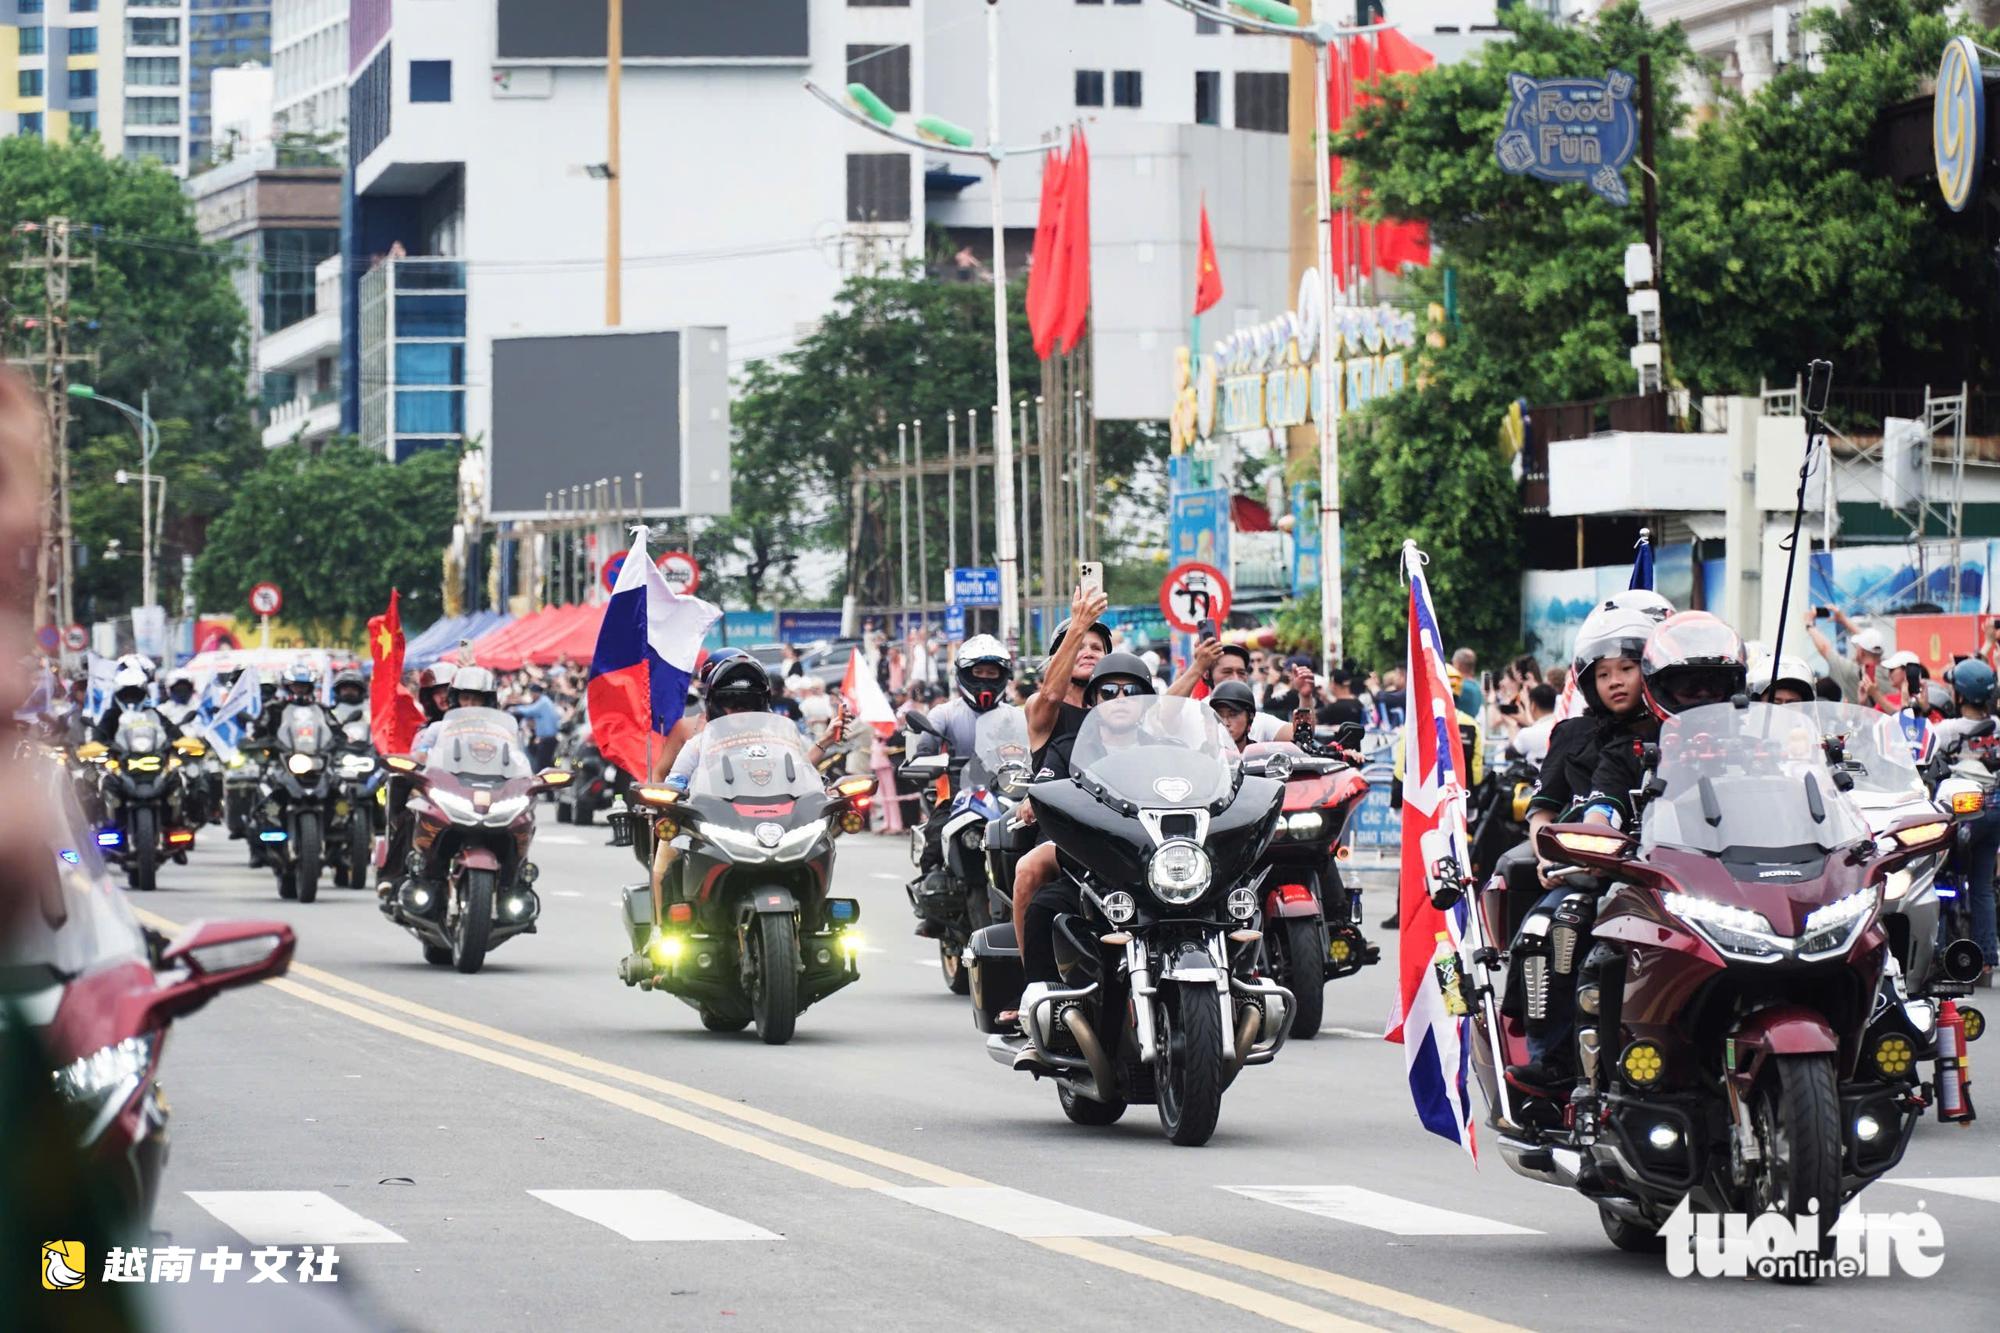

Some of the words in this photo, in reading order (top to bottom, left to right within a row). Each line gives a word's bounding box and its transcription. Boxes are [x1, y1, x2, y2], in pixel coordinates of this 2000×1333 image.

[1538, 87, 1614, 122] Food
[1539, 124, 1602, 164] Fun
[1759, 870, 1802, 878] HONDA
